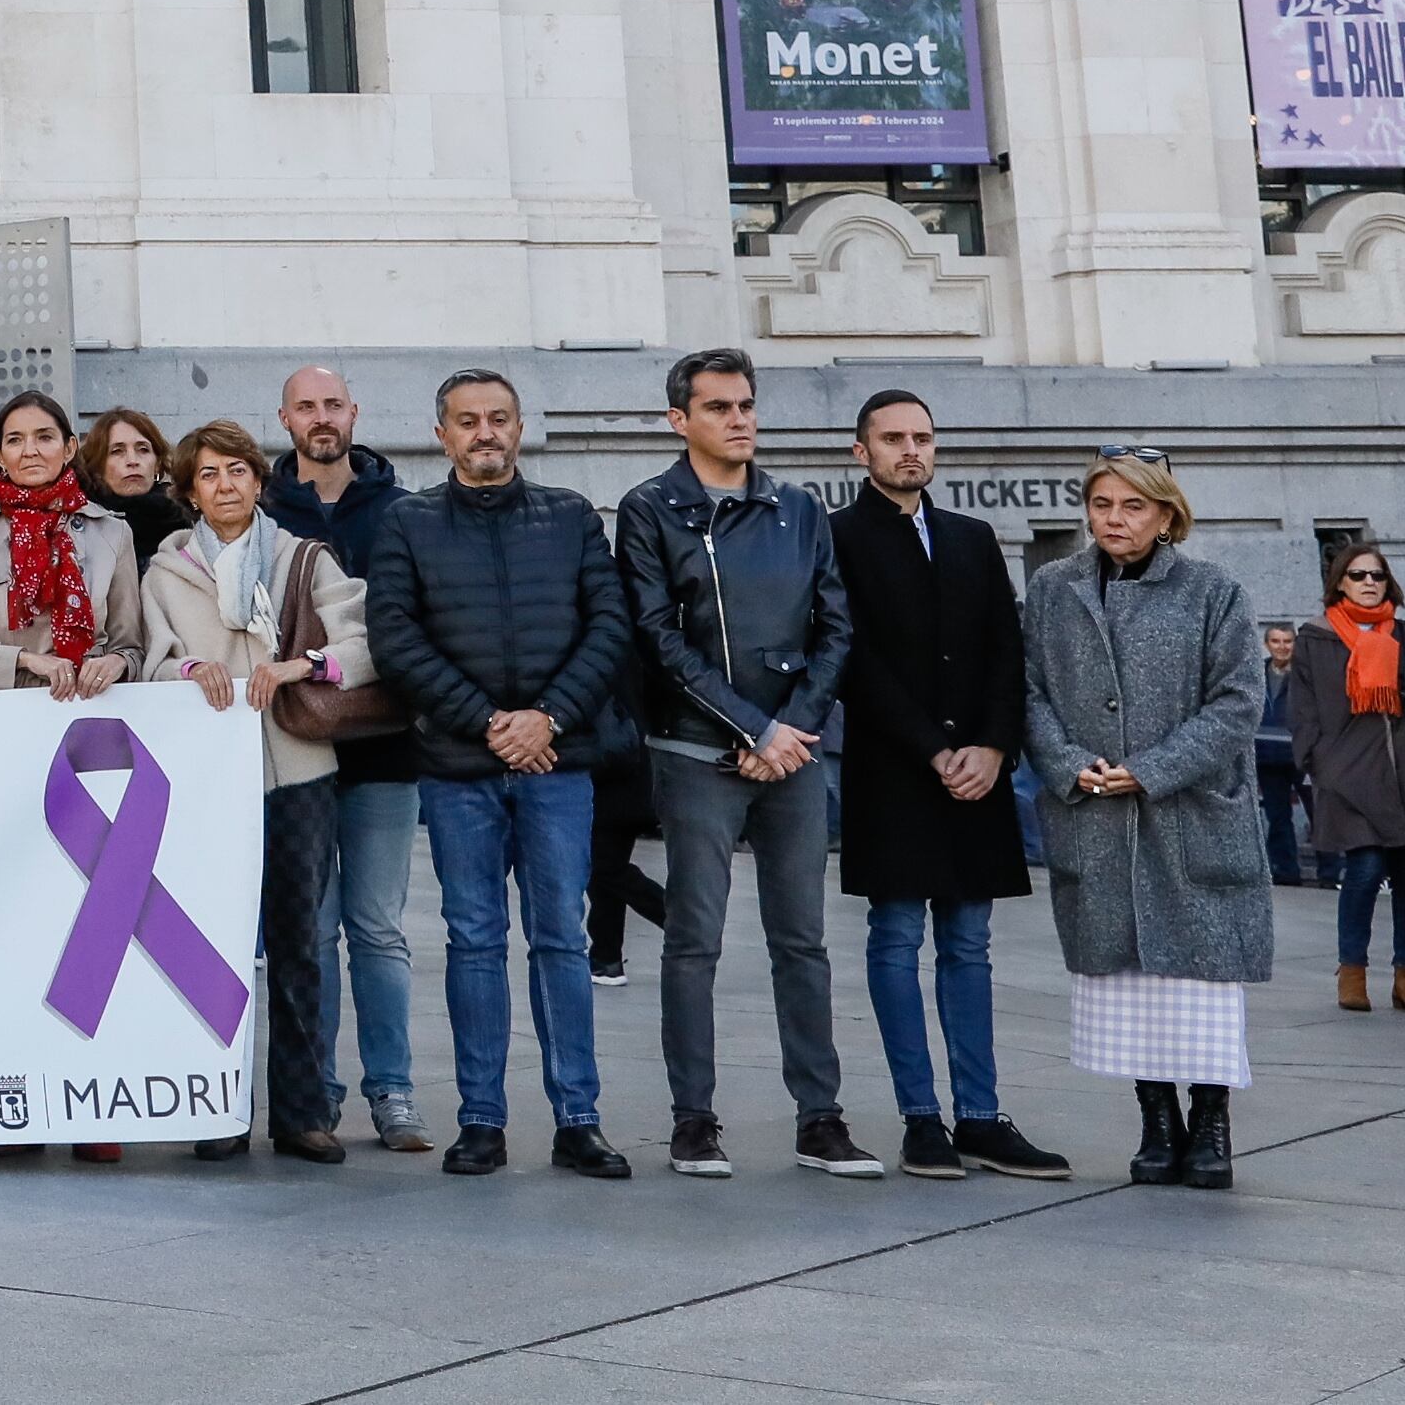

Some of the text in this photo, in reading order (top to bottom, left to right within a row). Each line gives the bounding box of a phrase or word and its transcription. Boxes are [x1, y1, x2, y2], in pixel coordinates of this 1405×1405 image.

[766, 31, 941, 76] Monet
[1307, 21, 1344, 98] EL
[773, 117, 784, 126] 21
[785, 116, 838, 127] septiembre
[884, 116, 919, 125] febrero
[920, 117, 945, 125] 2024
[946, 478, 1084, 509] TICKETS
[63, 1068, 241, 1120] MADRI
